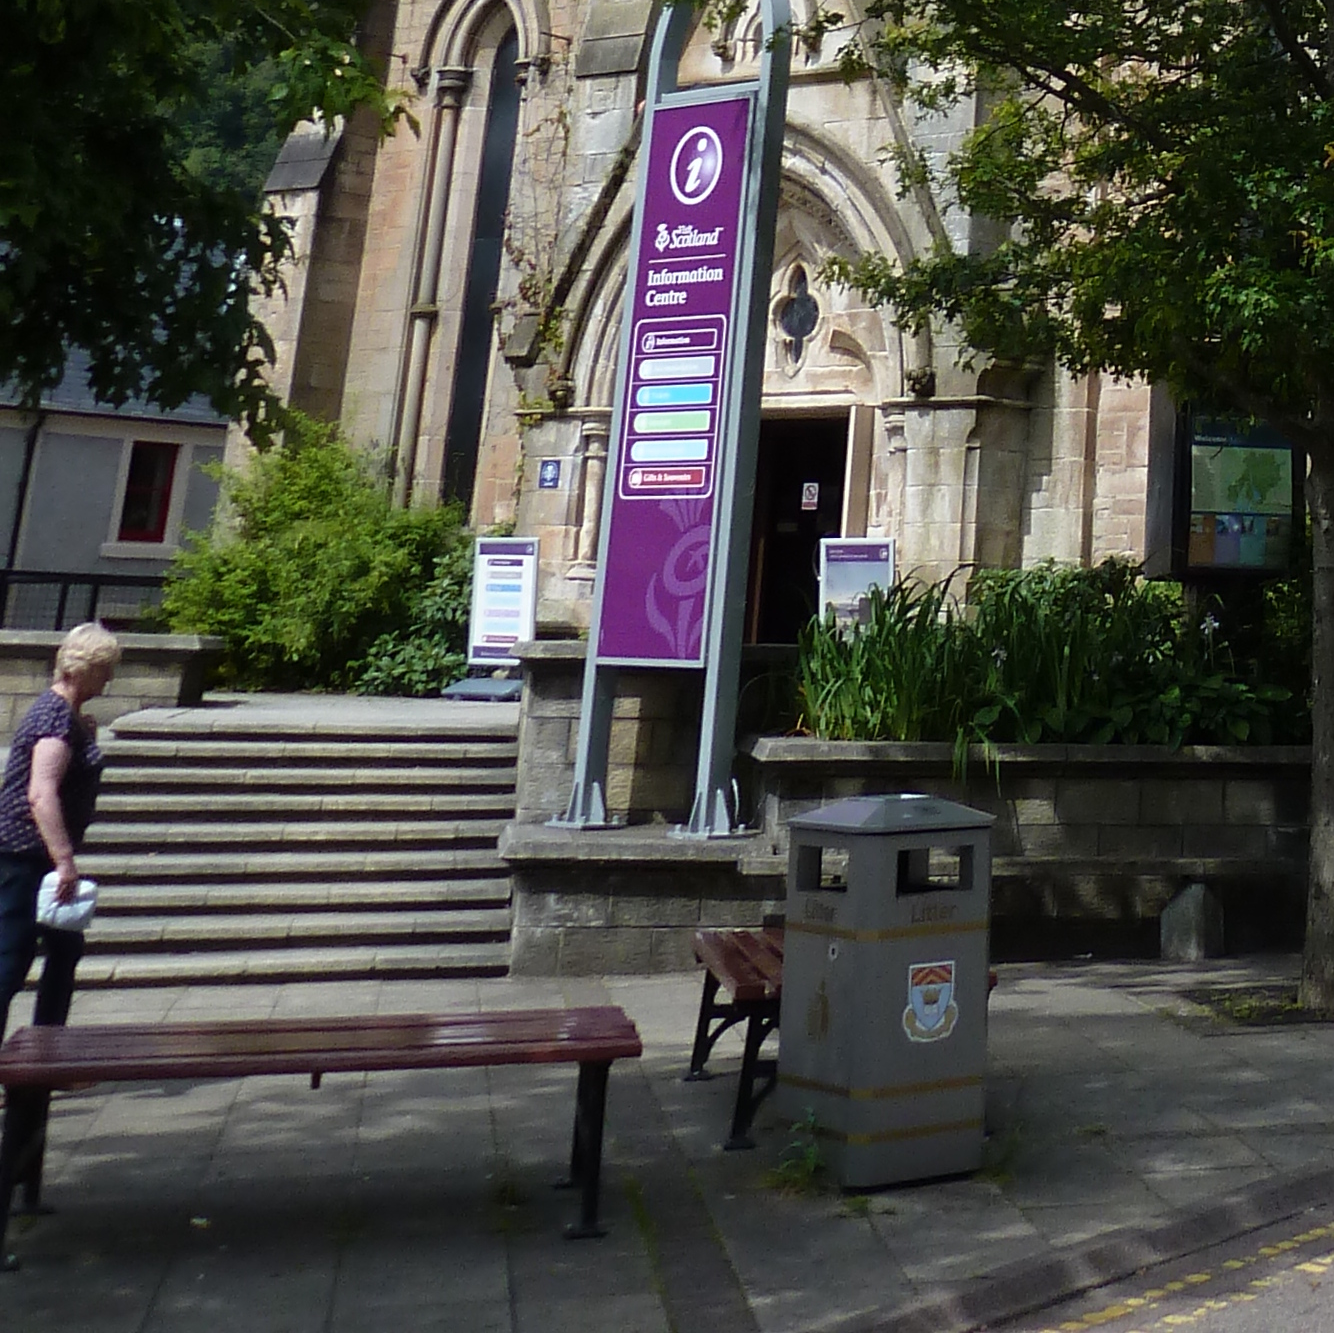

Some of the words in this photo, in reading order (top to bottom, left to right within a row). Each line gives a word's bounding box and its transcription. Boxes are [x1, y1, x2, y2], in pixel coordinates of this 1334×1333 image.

[668, 227, 724, 249] Scotland
[647, 265, 724, 287] Information
[645, 289, 687, 307] Centre
